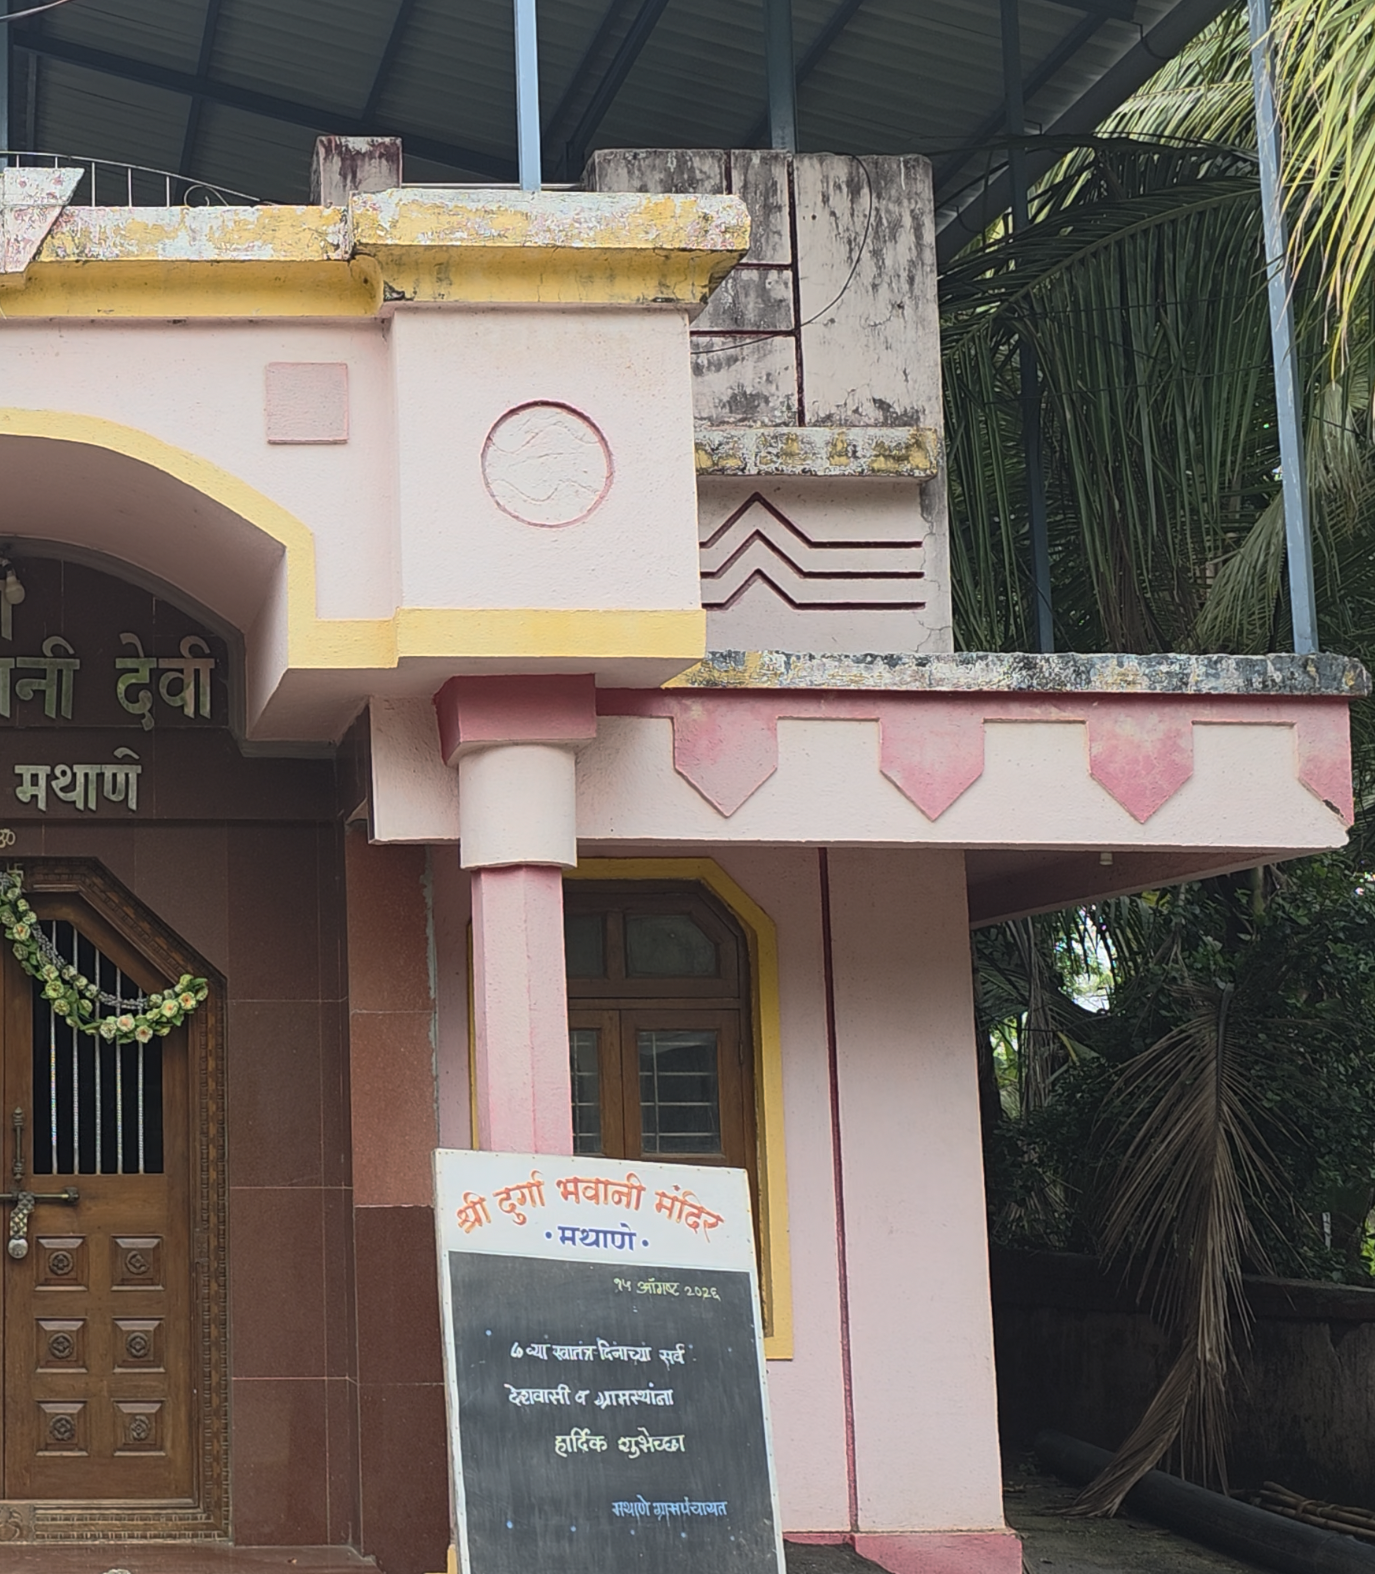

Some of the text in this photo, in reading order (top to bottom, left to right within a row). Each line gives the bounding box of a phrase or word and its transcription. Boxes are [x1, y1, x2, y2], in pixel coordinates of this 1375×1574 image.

[115, 632, 216, 731] देवी
[14, 747, 143, 812] मथाणे
[456, 1169, 725, 1243] श्री दुर्गा भवानी मंदिर
[557, 1222, 637, 1251] मथाणे
[613, 1277, 632, 1292] १५
[659, 1343, 686, 1366] सर्व
[574, 1389, 590, 1406] व
[554, 1427, 608, 1458] हार्दिक
